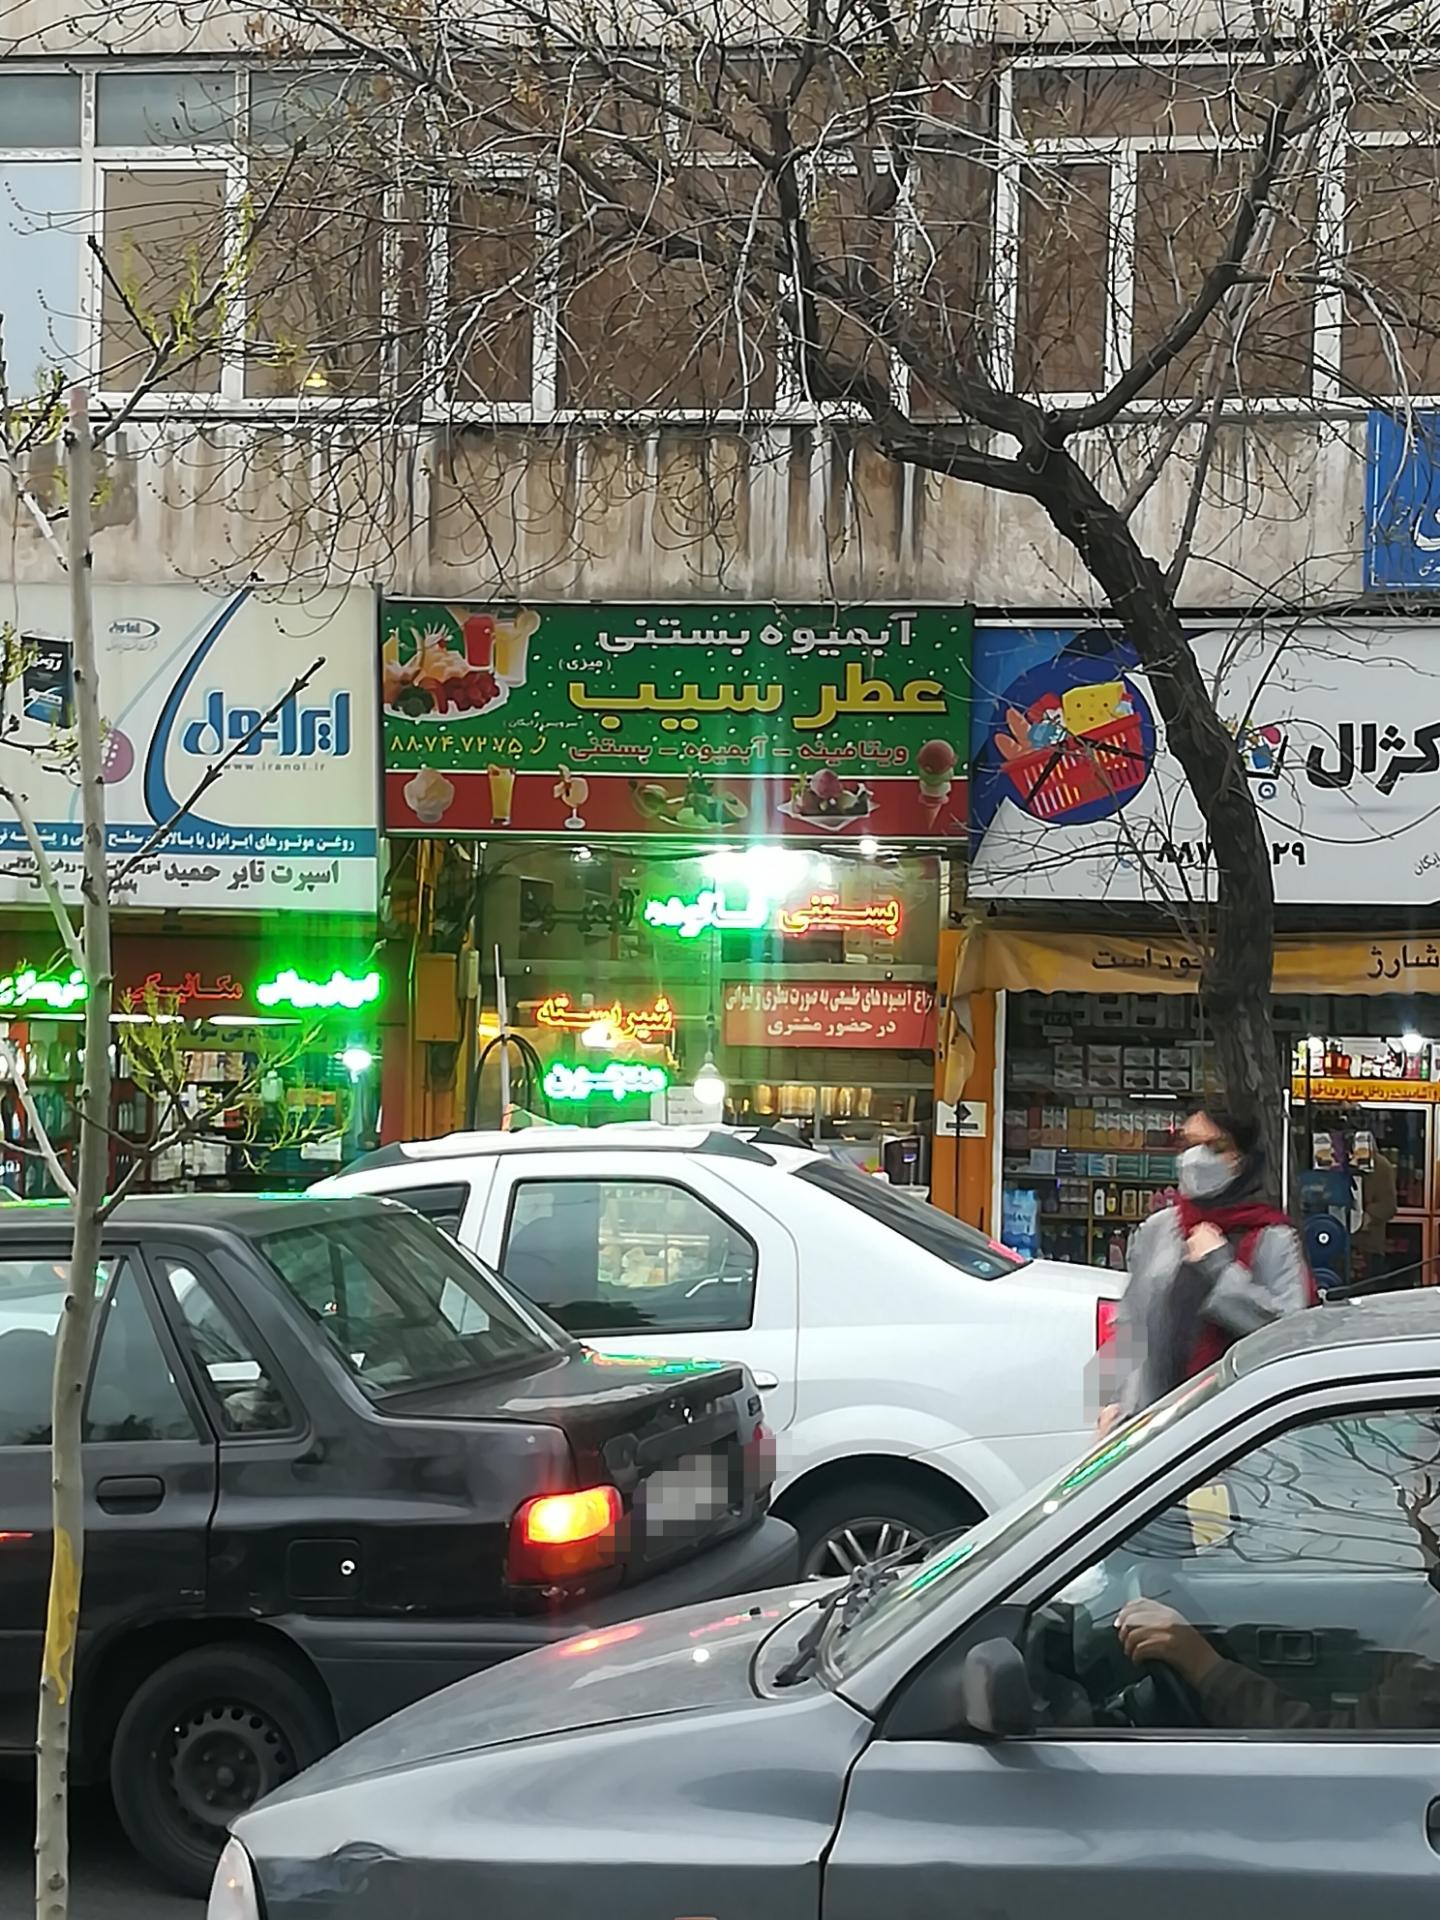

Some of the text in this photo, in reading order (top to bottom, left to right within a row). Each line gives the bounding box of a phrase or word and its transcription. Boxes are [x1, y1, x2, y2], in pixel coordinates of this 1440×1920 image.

[600, 613, 914, 655] آبمیوه بستنی
[567, 662, 949, 732] عطر سیب
[181, 691, 351, 757] ایرانول
[569, 738, 651, 761] بستنی
[683, 736, 768, 764] آبمیوه
[799, 737, 908, 765] ویتامینه
[206, 832, 253, 851] ایرانول
[254, 833, 315, 852] موتورهای
[316, 834, 355, 852] روغن
[164, 862, 221, 888] حمید
[226, 859, 266, 890] تایر
[270, 860, 340, 892] اسپرت
[777, 896, 901, 936] بستنی
[621, 996, 673, 1040] شیر
[767, 1017, 897, 1037] در حضور مشتری
